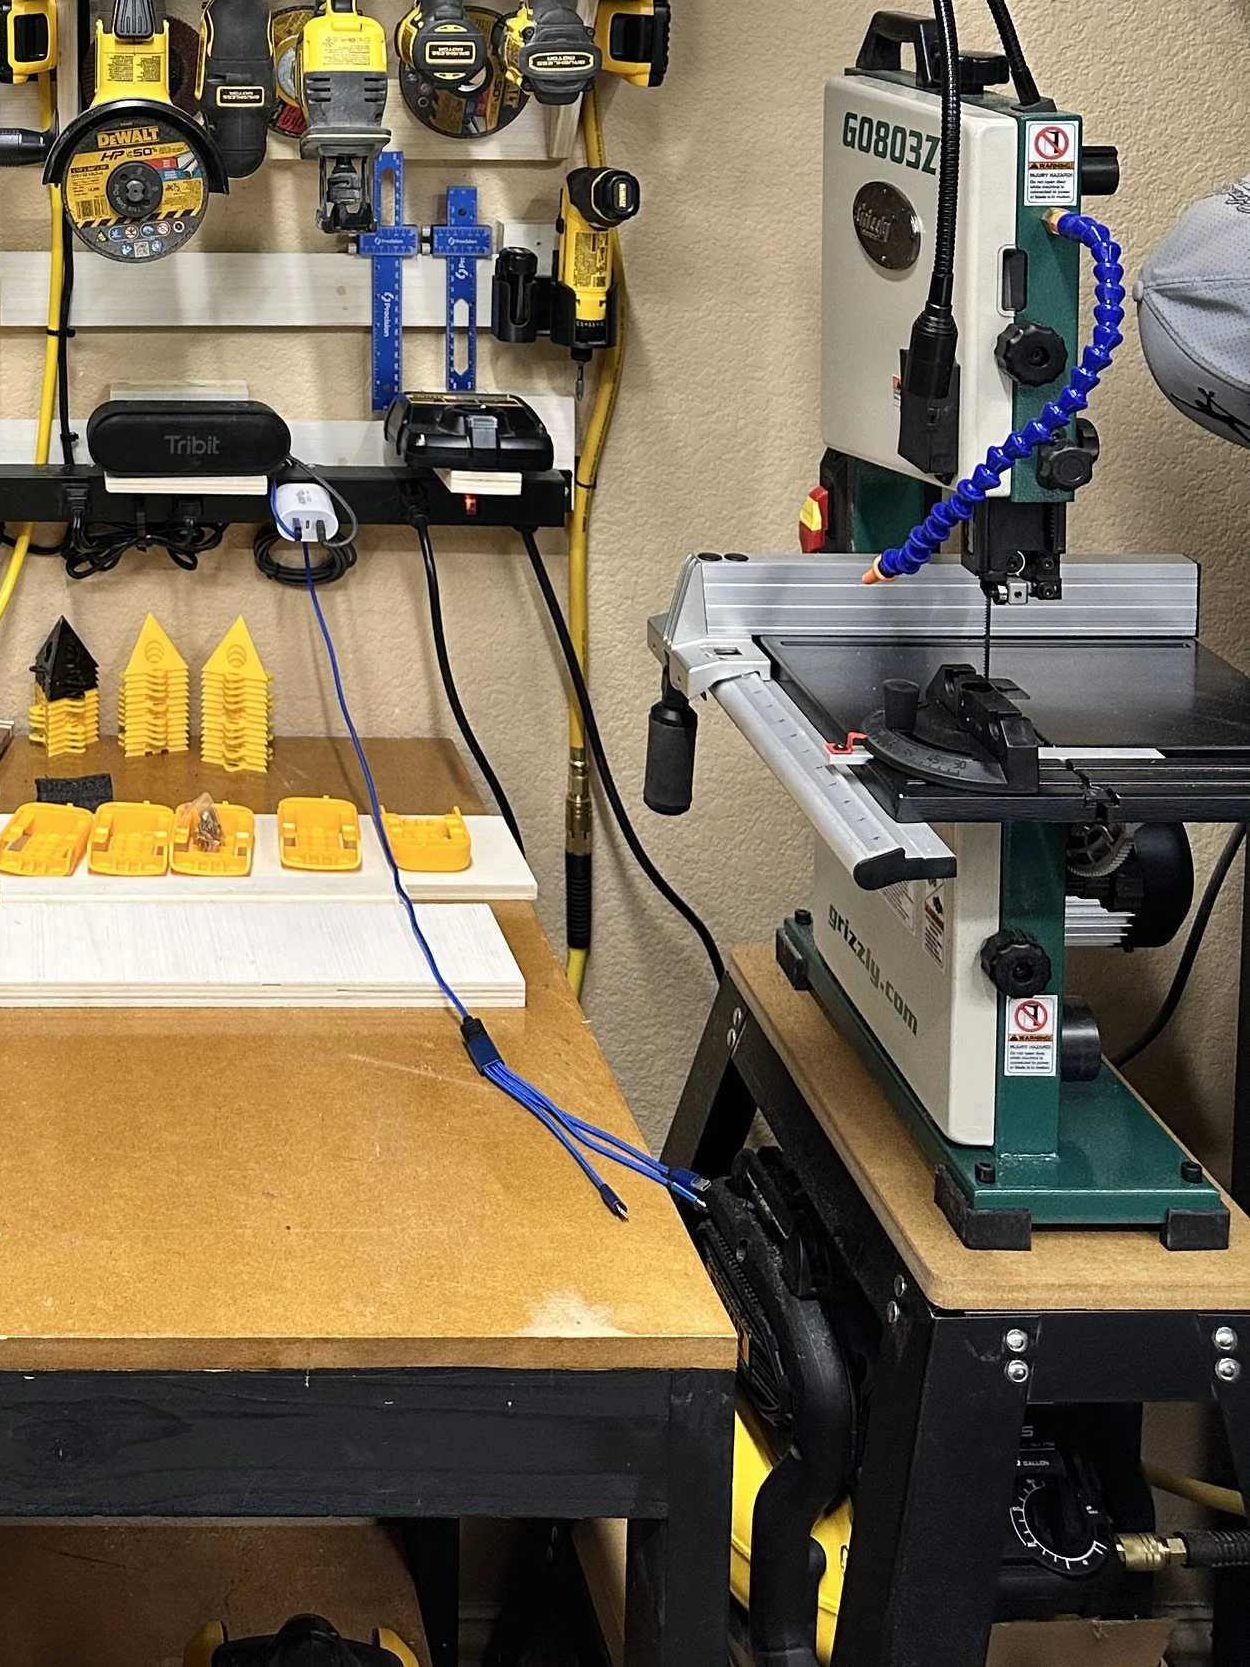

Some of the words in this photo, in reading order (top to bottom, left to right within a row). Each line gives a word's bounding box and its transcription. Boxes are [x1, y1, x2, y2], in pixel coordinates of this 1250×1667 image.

[98, 127, 159, 147] DEWALT
[100, 150, 125, 161] HP
[164, 435, 221, 455] Tribit
[952, 760, 967, 770] 30
[828, 904, 918, 1037] grizzly.com
